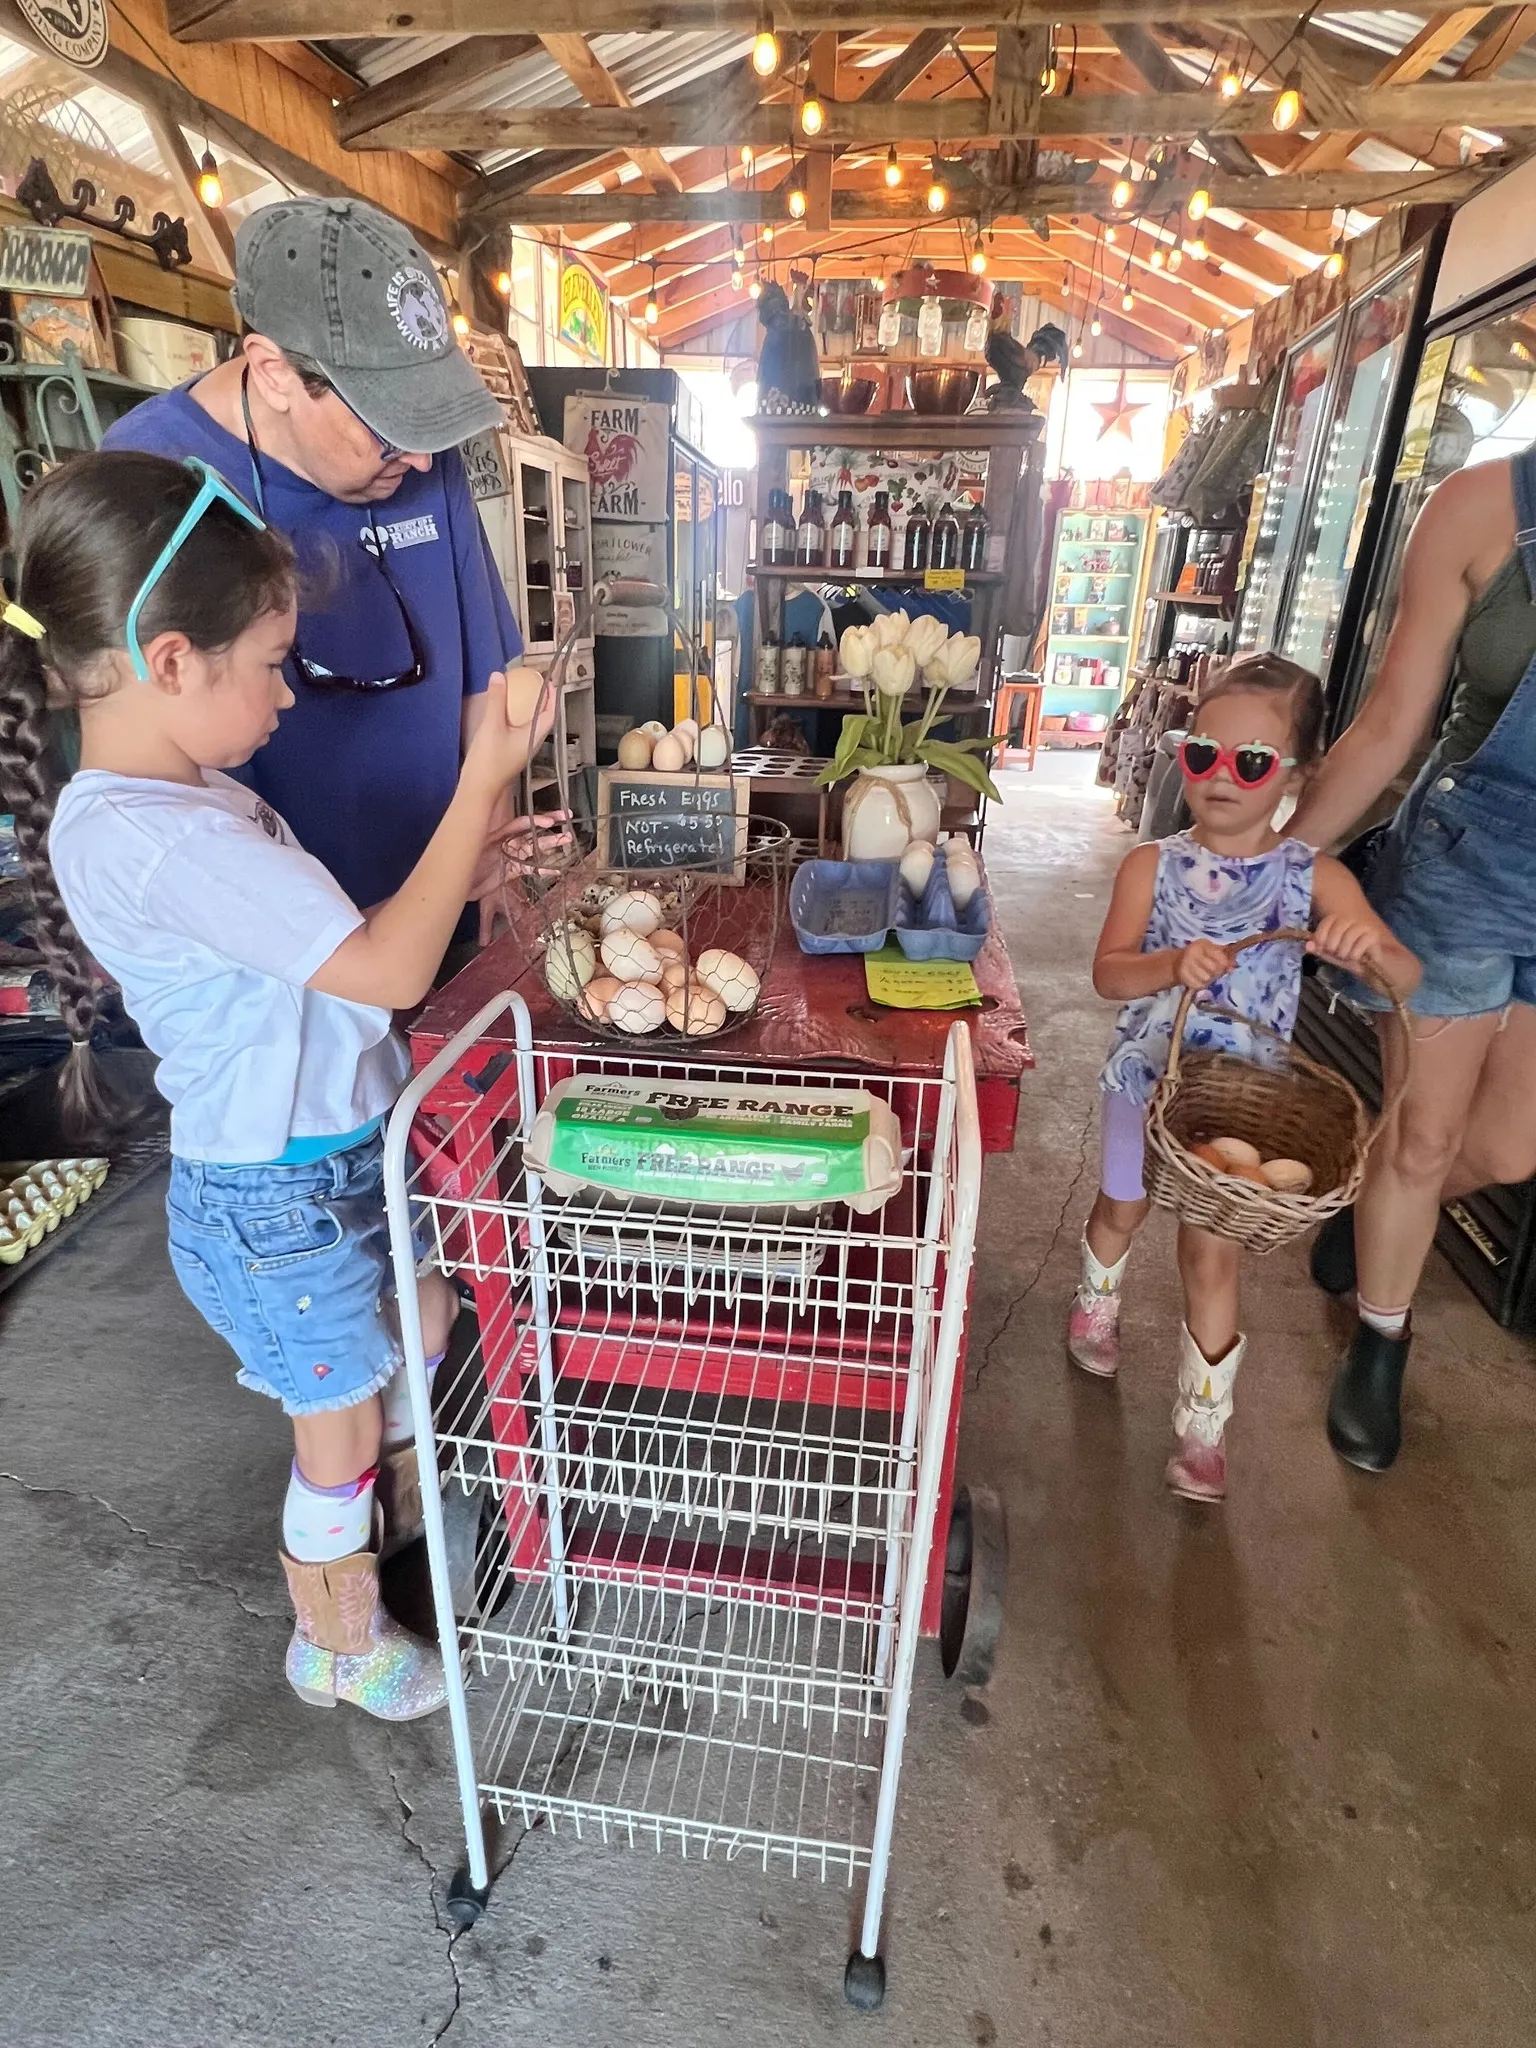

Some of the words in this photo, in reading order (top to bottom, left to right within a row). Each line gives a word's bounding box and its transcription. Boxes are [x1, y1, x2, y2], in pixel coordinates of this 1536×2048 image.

[65, 20, 102, 57] COMPANY
[391, 271, 405, 286] IS
[387, 284, 400, 317] LIFE
[397, 320, 429, 350] WITH
[591, 408, 639, 435] FARM
[592, 488, 639, 515] ARM
[718, 470, 743, 506] ello
[390, 523, 437, 544] RANCH
[585, 1085, 641, 1097] Farmers
[646, 1092, 729, 1110] FREE
[736, 1099, 854, 1116] RANGE
[582, 1152, 631, 1168] Farmers
[636, 1152, 692, 1174] FREE
[697, 1158, 776, 1180] RANGE
